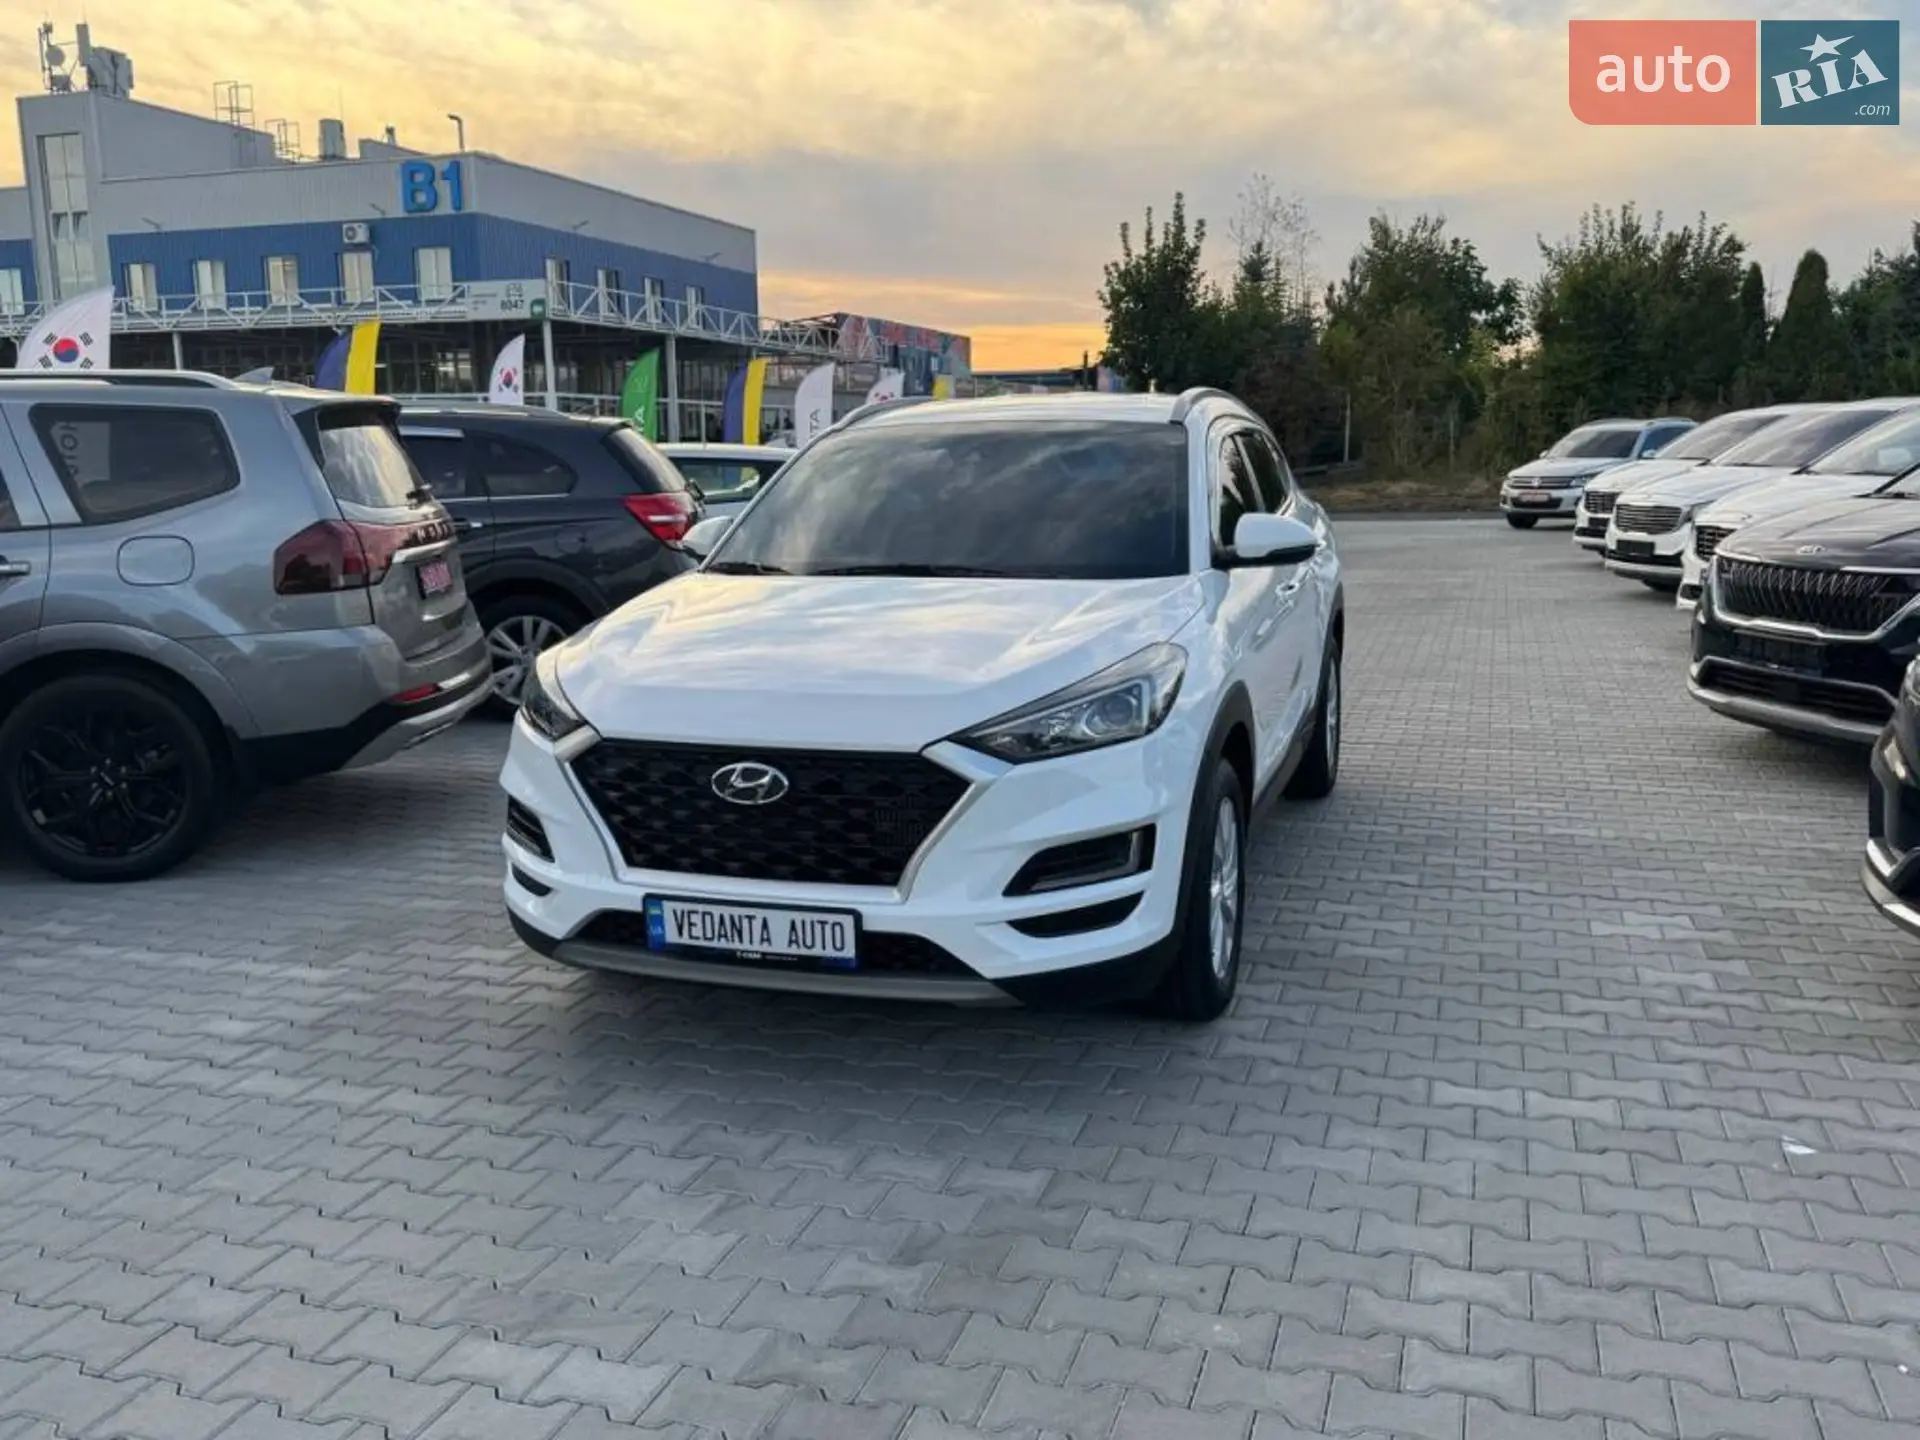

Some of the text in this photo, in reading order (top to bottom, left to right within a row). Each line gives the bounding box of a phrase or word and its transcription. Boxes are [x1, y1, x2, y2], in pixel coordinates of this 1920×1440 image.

[401, 160, 462, 214] B1
[672, 908, 846, 952] VEDANTA AUTO
